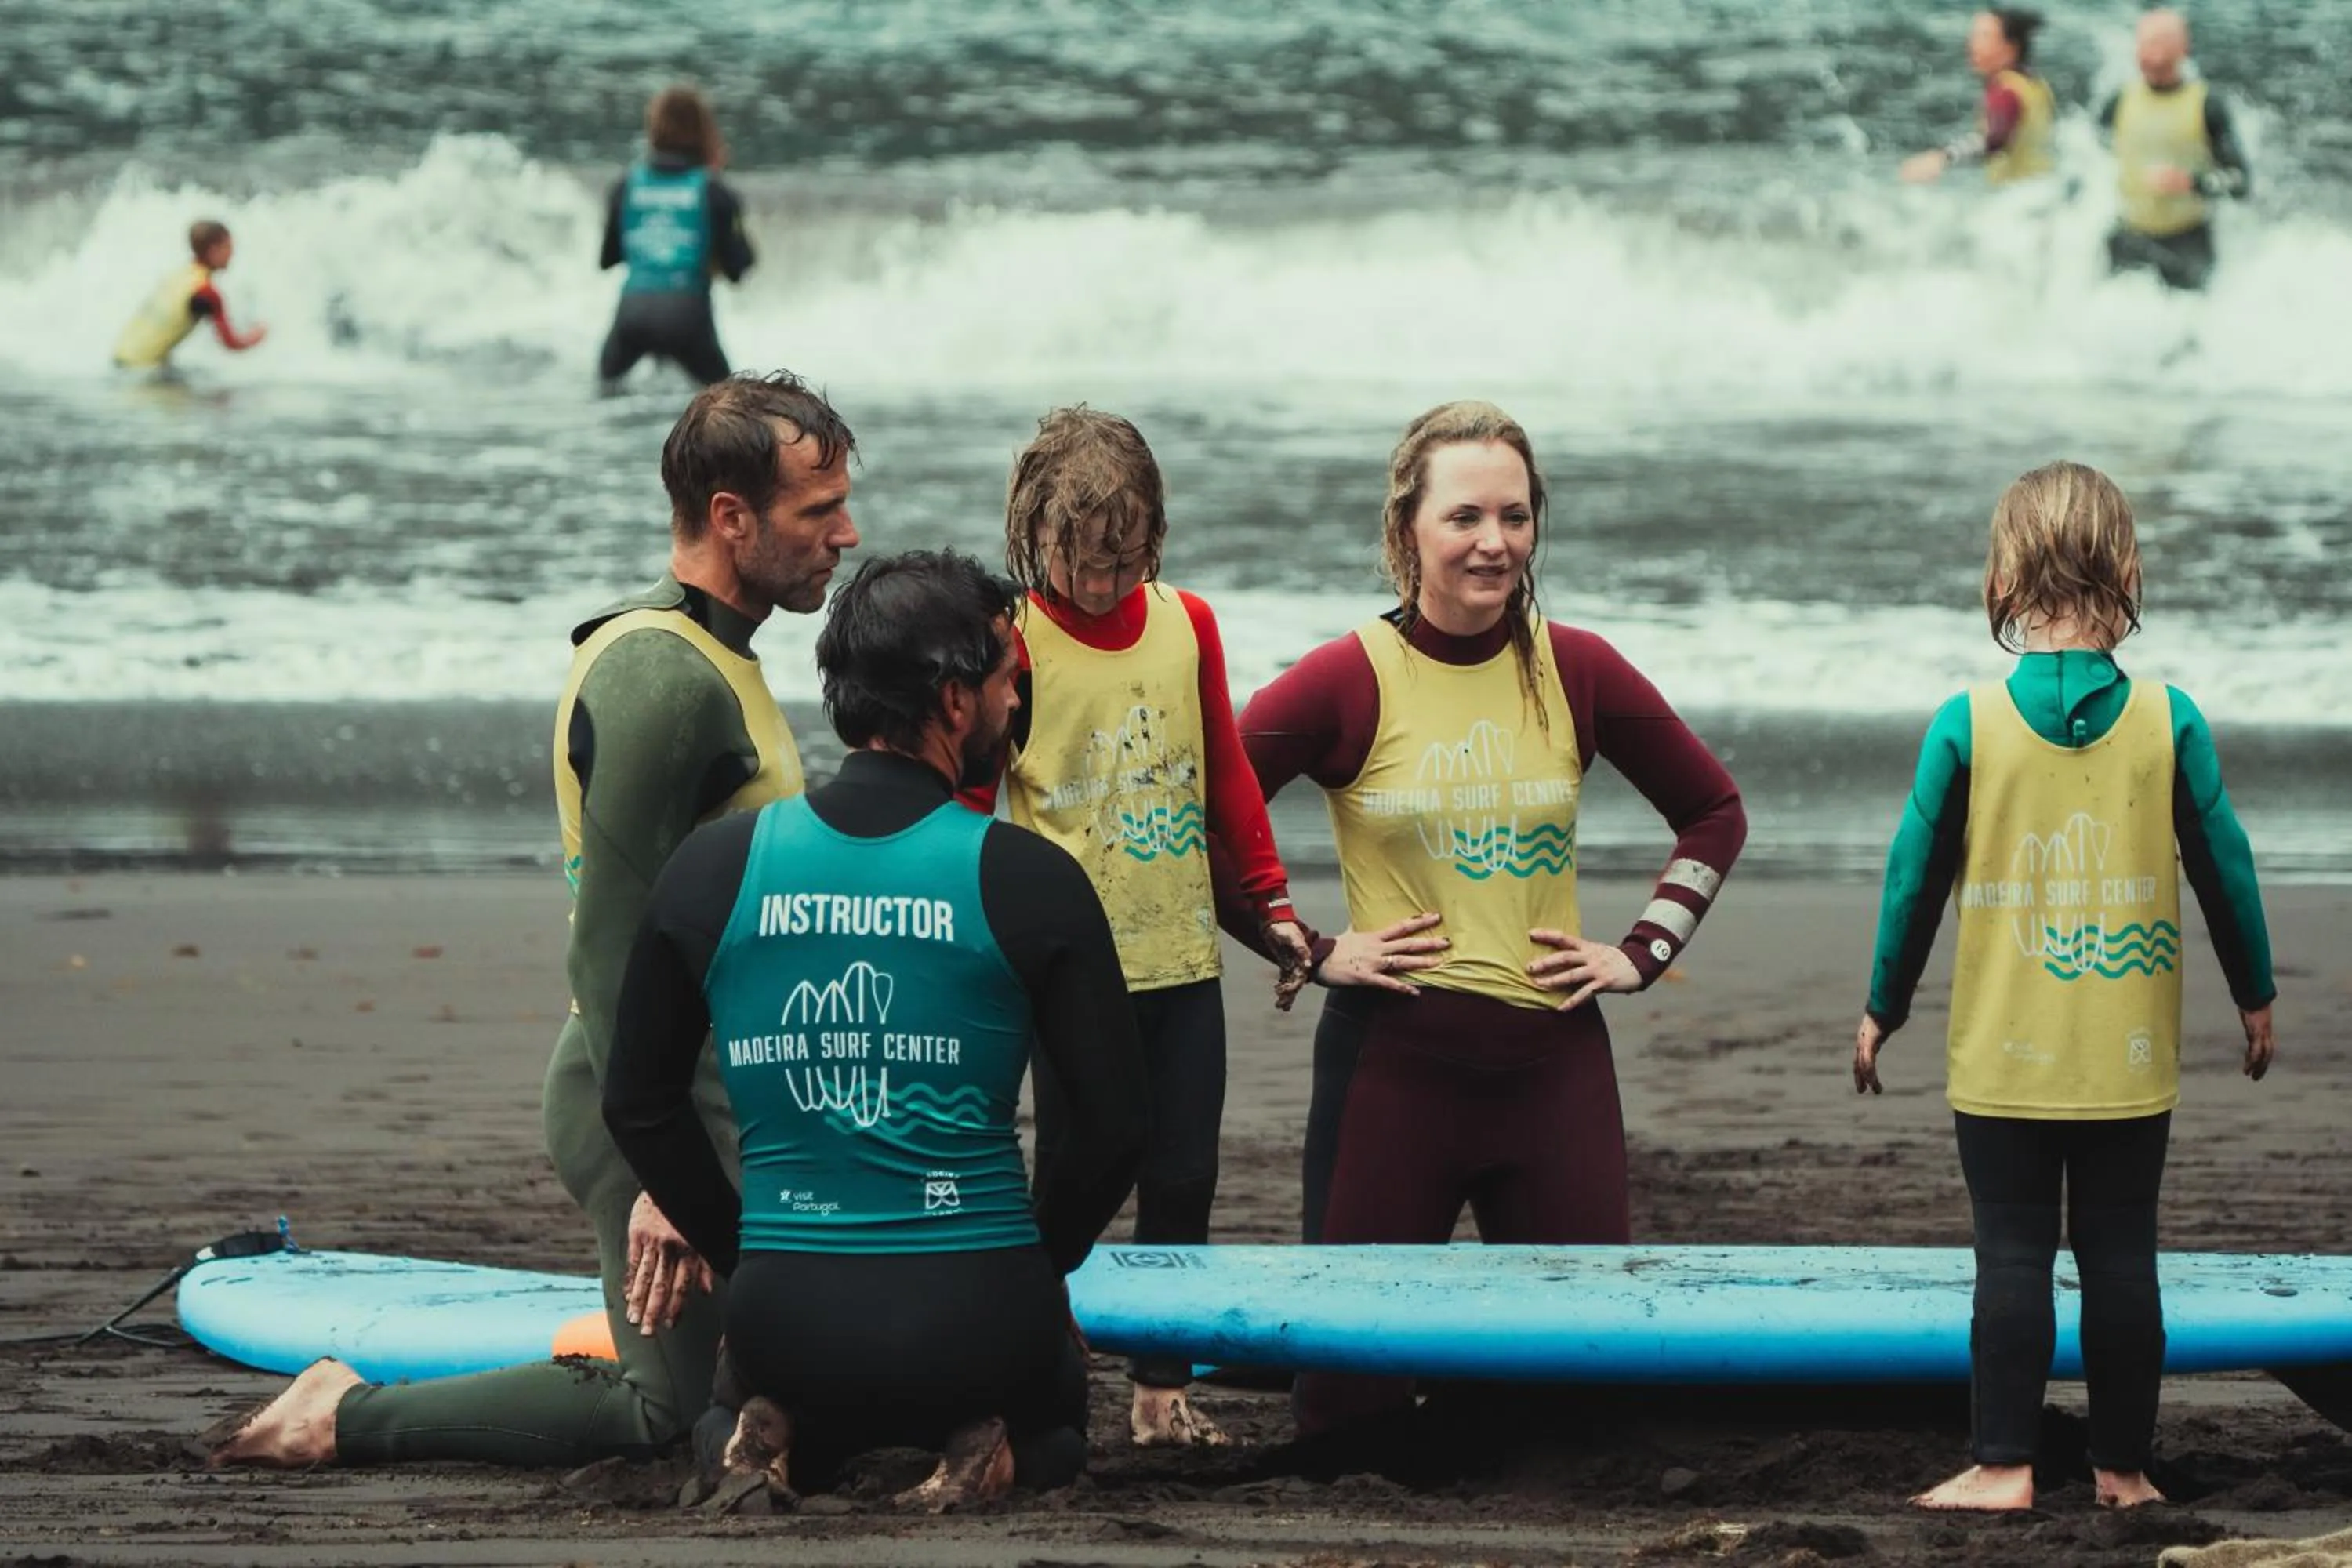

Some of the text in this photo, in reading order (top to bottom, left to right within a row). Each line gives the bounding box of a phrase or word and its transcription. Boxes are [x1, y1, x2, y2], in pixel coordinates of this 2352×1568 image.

[1452, 783, 1501, 811] SURF
[1962, 880, 2034, 909] MADEIRA
[2045, 879, 2091, 906] SURF
[759, 893, 954, 942] INSTRUCTOR
[728, 1032, 960, 1067] MADEIRA SURF CENTER
